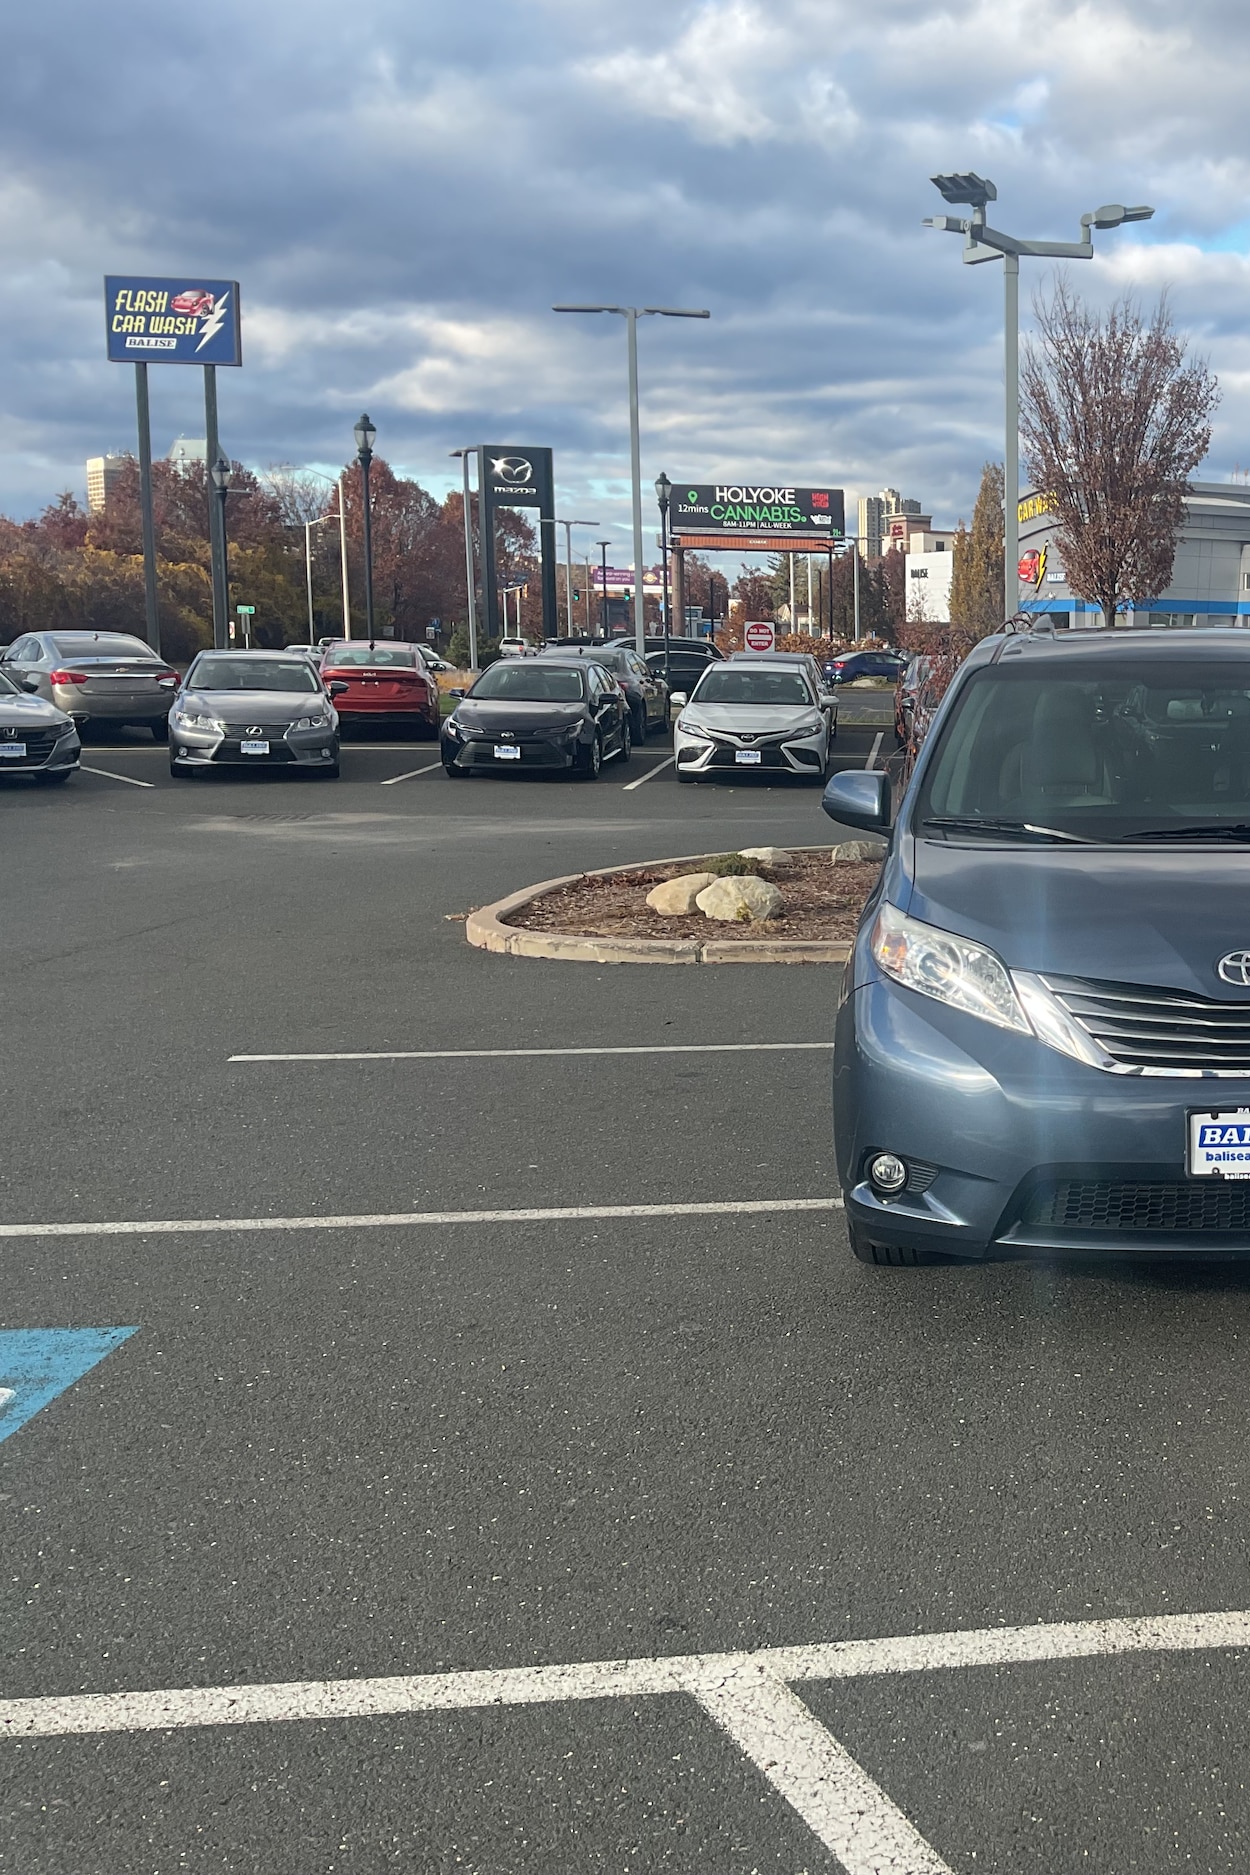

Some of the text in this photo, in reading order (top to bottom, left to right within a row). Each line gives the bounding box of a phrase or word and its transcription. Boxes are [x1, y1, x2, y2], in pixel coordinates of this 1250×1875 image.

[115, 289, 169, 313] FLASH
[111, 314, 198, 335] CAR WASH
[128, 338, 175, 348] BALISE
[715, 486, 796, 505] HOLYOKE
[678, 503, 709, 514] 12mins
